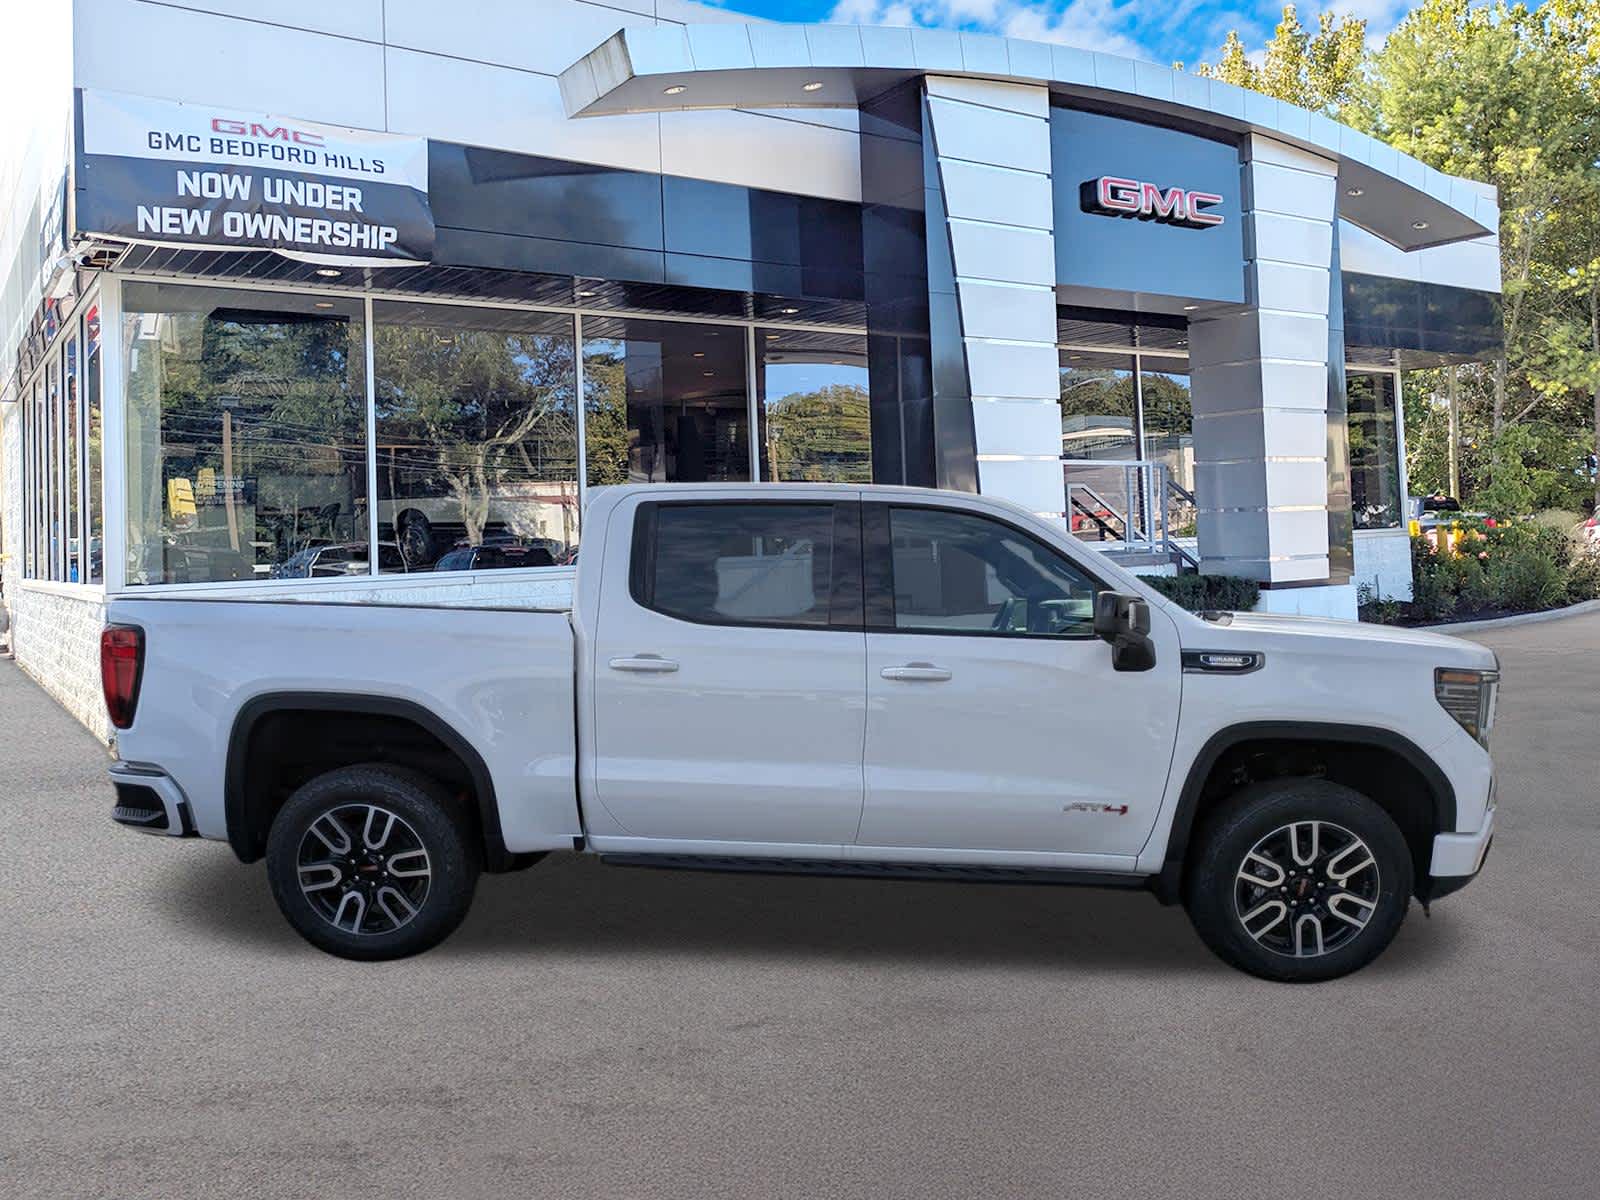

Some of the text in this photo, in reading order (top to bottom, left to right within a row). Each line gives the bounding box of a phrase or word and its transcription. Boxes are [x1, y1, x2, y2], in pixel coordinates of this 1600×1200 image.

[148, 131, 385, 174] GMC BEDFORD HILLS
[211, 118, 326, 147] GMC
[177, 170, 363, 213] NOW UNDER
[1098, 176, 1224, 224] GMC
[136, 206, 398, 250] NEW OWNERSHIP
